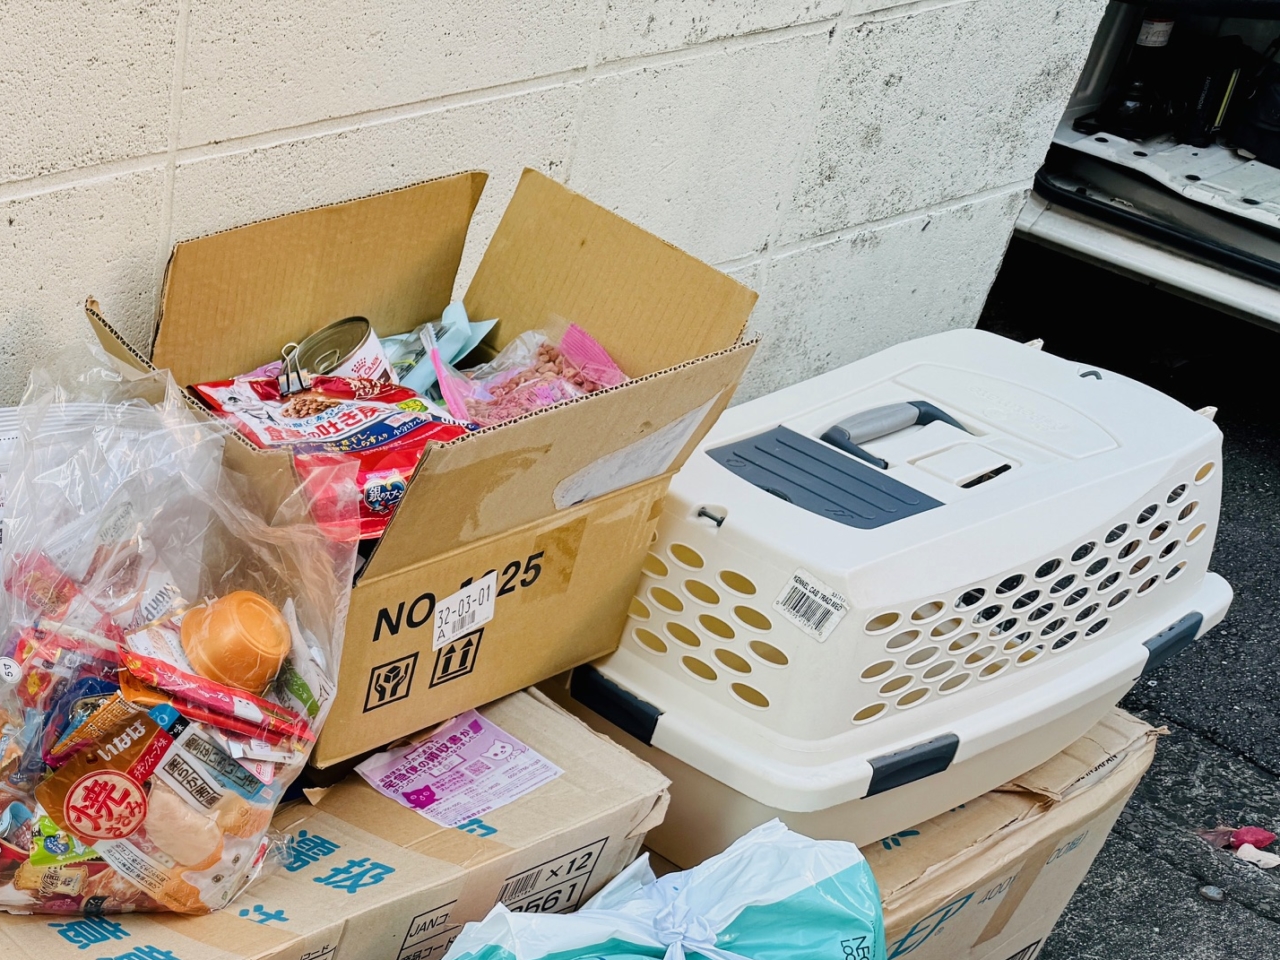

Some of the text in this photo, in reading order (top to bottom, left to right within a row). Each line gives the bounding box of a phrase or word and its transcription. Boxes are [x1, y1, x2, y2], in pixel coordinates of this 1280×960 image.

[437, 584, 492, 629] 32-03-01
[436, 629, 446, 642] A
[97, 718, 148, 762] いなば
[132, 737, 170, 780] チキンスープ味
